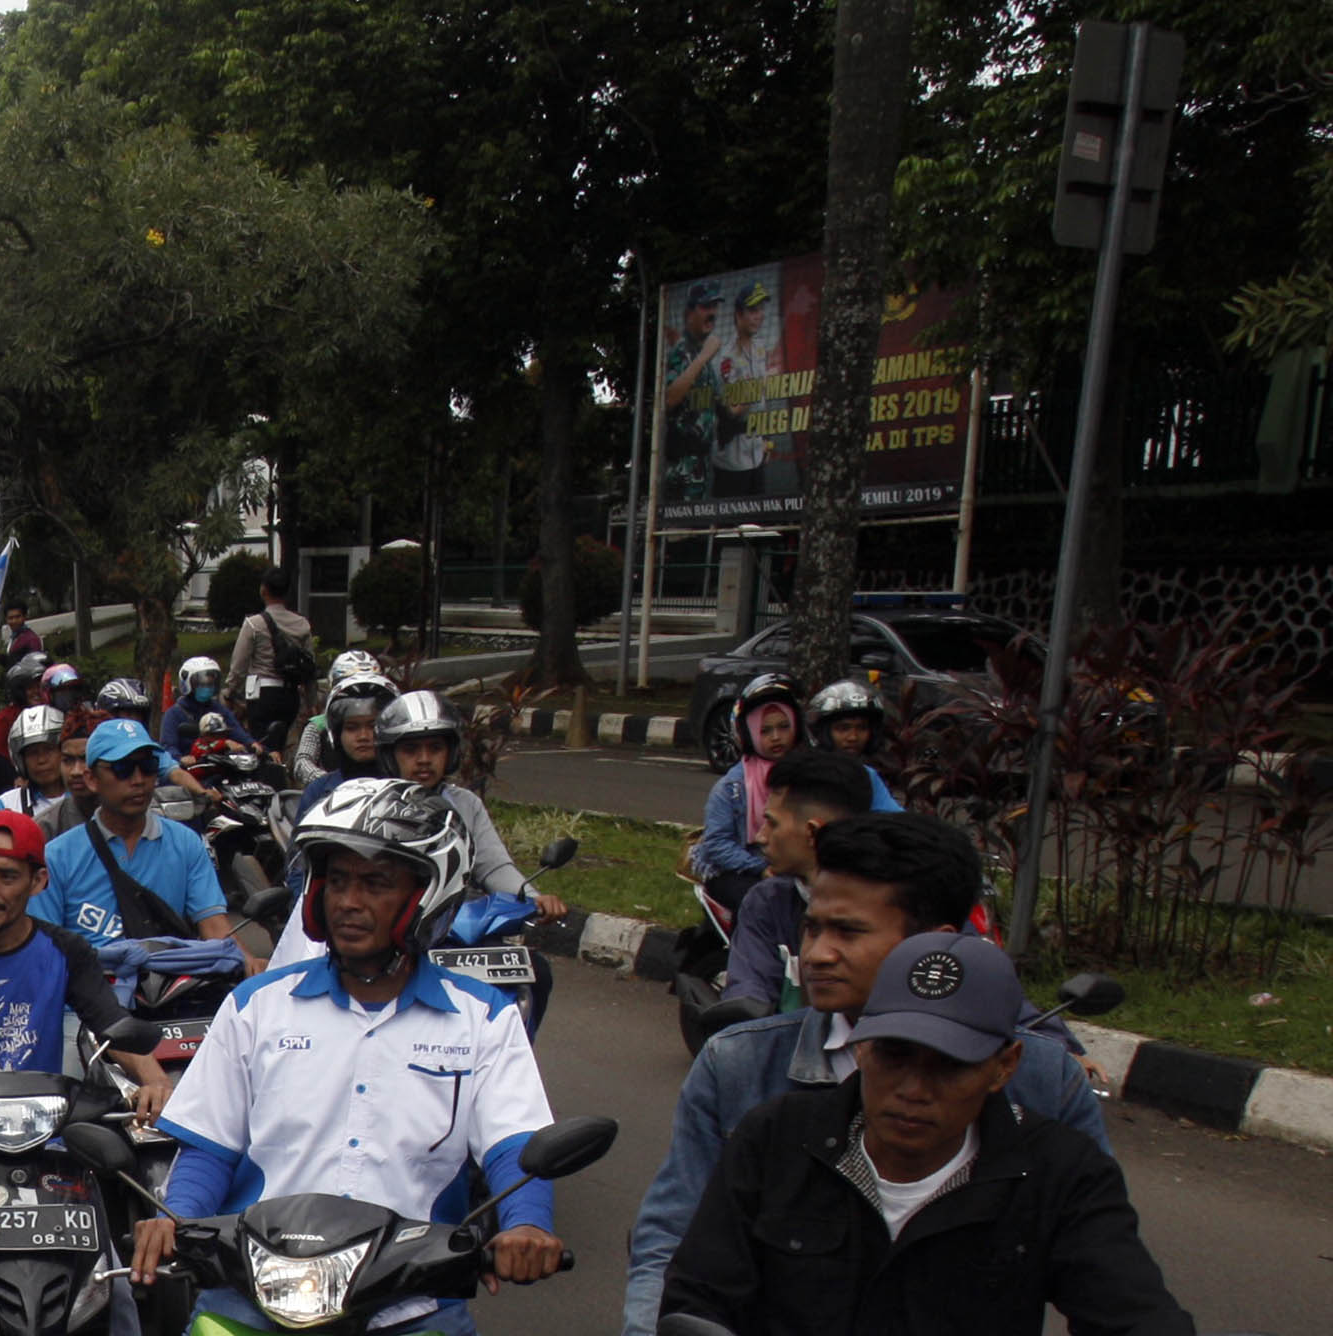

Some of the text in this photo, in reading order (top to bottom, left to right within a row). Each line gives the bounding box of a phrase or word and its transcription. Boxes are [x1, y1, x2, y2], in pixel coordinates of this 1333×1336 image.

[746, 410, 788, 438] PILEG
[902, 387, 960, 419] 2019
[888, 428, 908, 450] DI
[912, 424, 955, 448] TPS
[763, 500, 784, 514] HAK
[905, 486, 943, 503] 2019
[436, 952, 520, 967] F 4427 CR
[162, 1027, 183, 1040] 39
[278, 1035, 312, 1051] SPN
[413, 1043, 429, 1053] SPN
[64, 1209, 92, 1230] KD
[280, 1233, 326, 1242] HONDA
